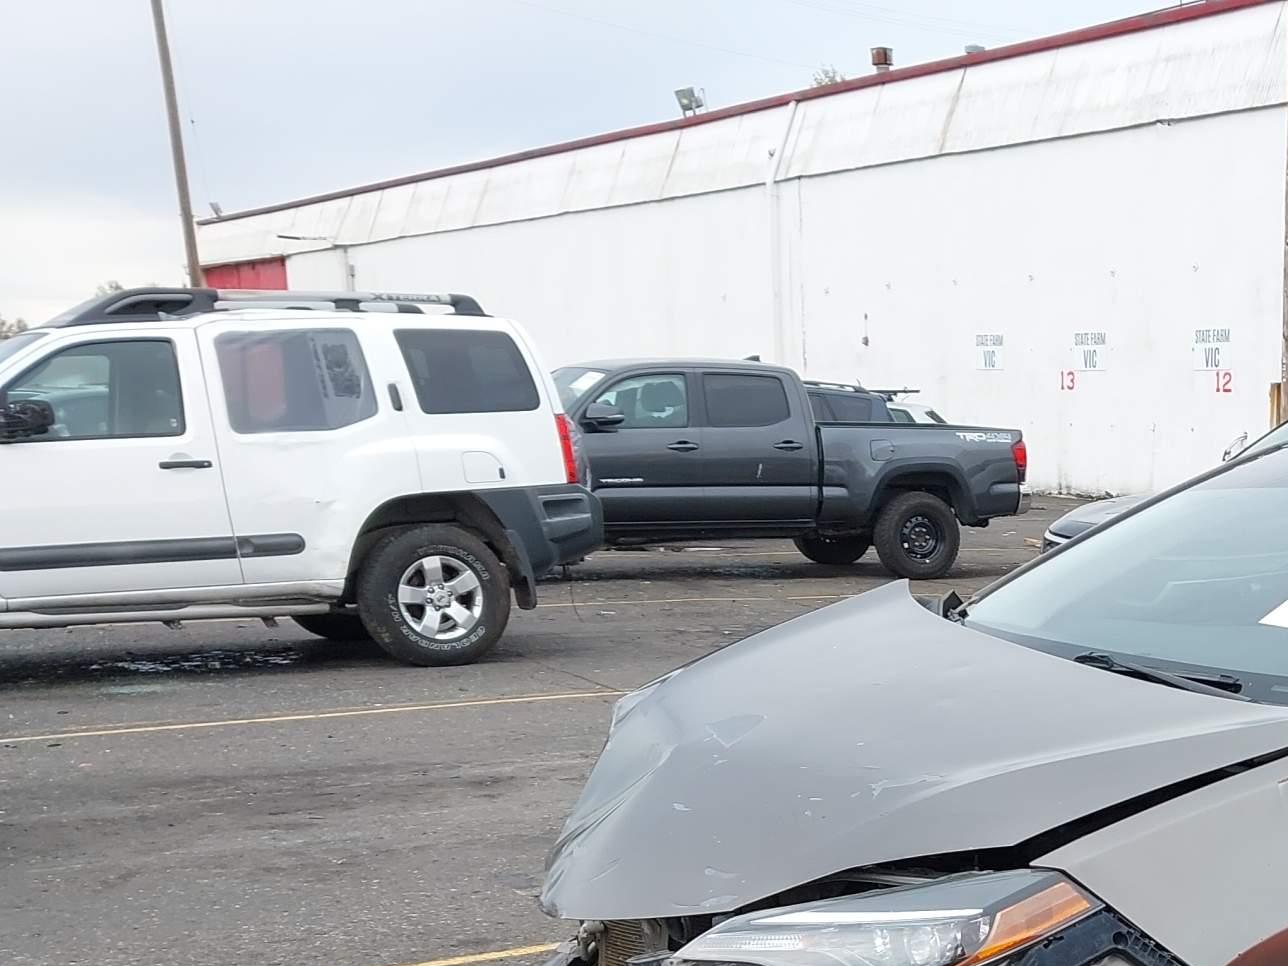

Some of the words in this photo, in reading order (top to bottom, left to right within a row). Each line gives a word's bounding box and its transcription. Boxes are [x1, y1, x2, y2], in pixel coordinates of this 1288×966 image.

[1195, 330, 1211, 344] STATE
[1212, 329, 1230, 343] FARM
[983, 350, 996, 368] VIC
[1083, 349, 1097, 369] VIC
[1204, 347, 1220, 368] VIC
[1061, 371, 1075, 391] 13
[1216, 371, 1232, 392] 12
